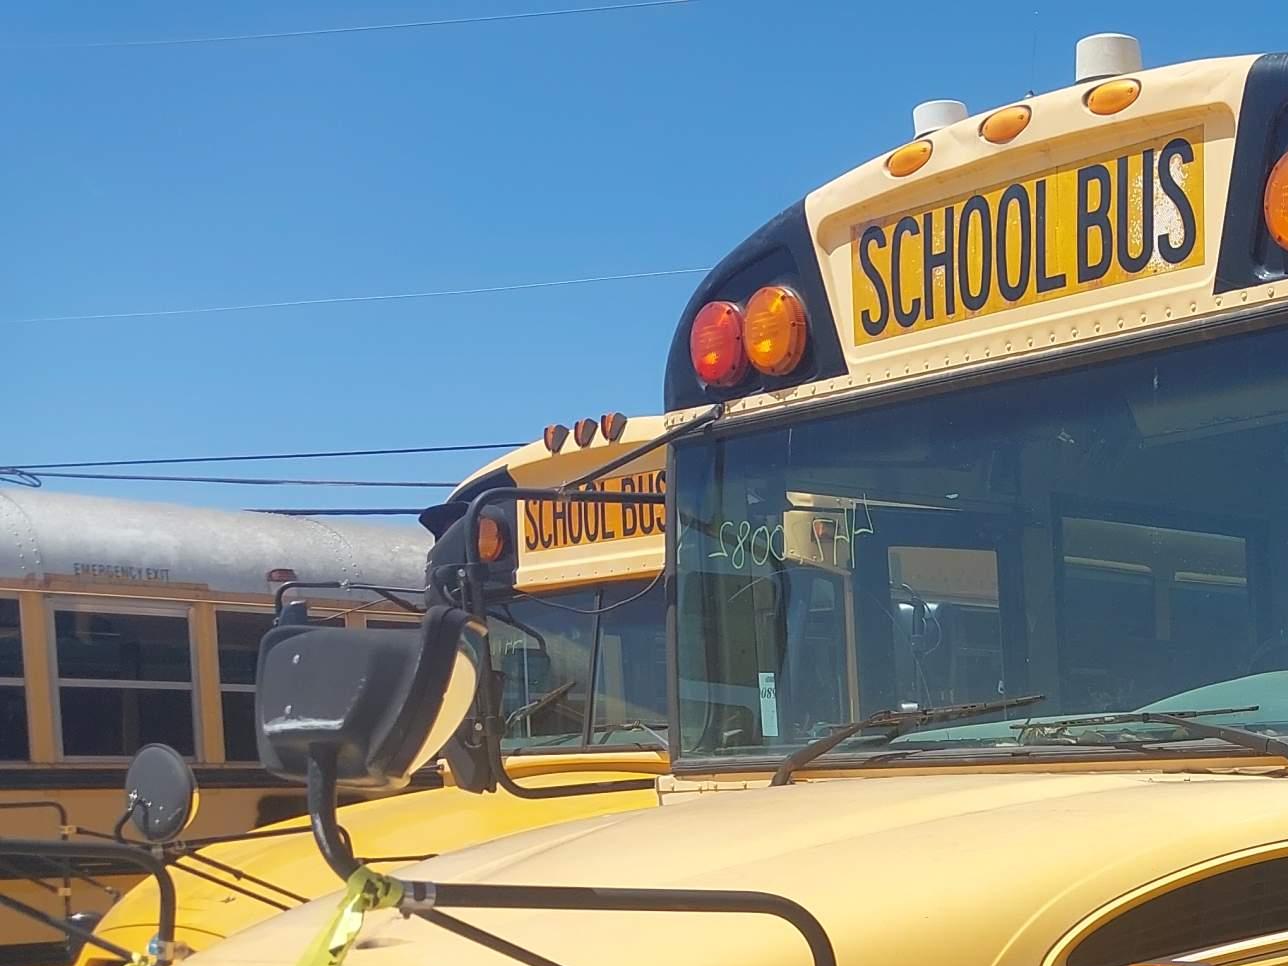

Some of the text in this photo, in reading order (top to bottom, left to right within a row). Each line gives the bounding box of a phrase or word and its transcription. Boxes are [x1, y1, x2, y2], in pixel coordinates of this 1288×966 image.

[859, 137, 1197, 337] SCHOOL BUS
[73, 562, 169, 582] EMERGENCY EXIT
